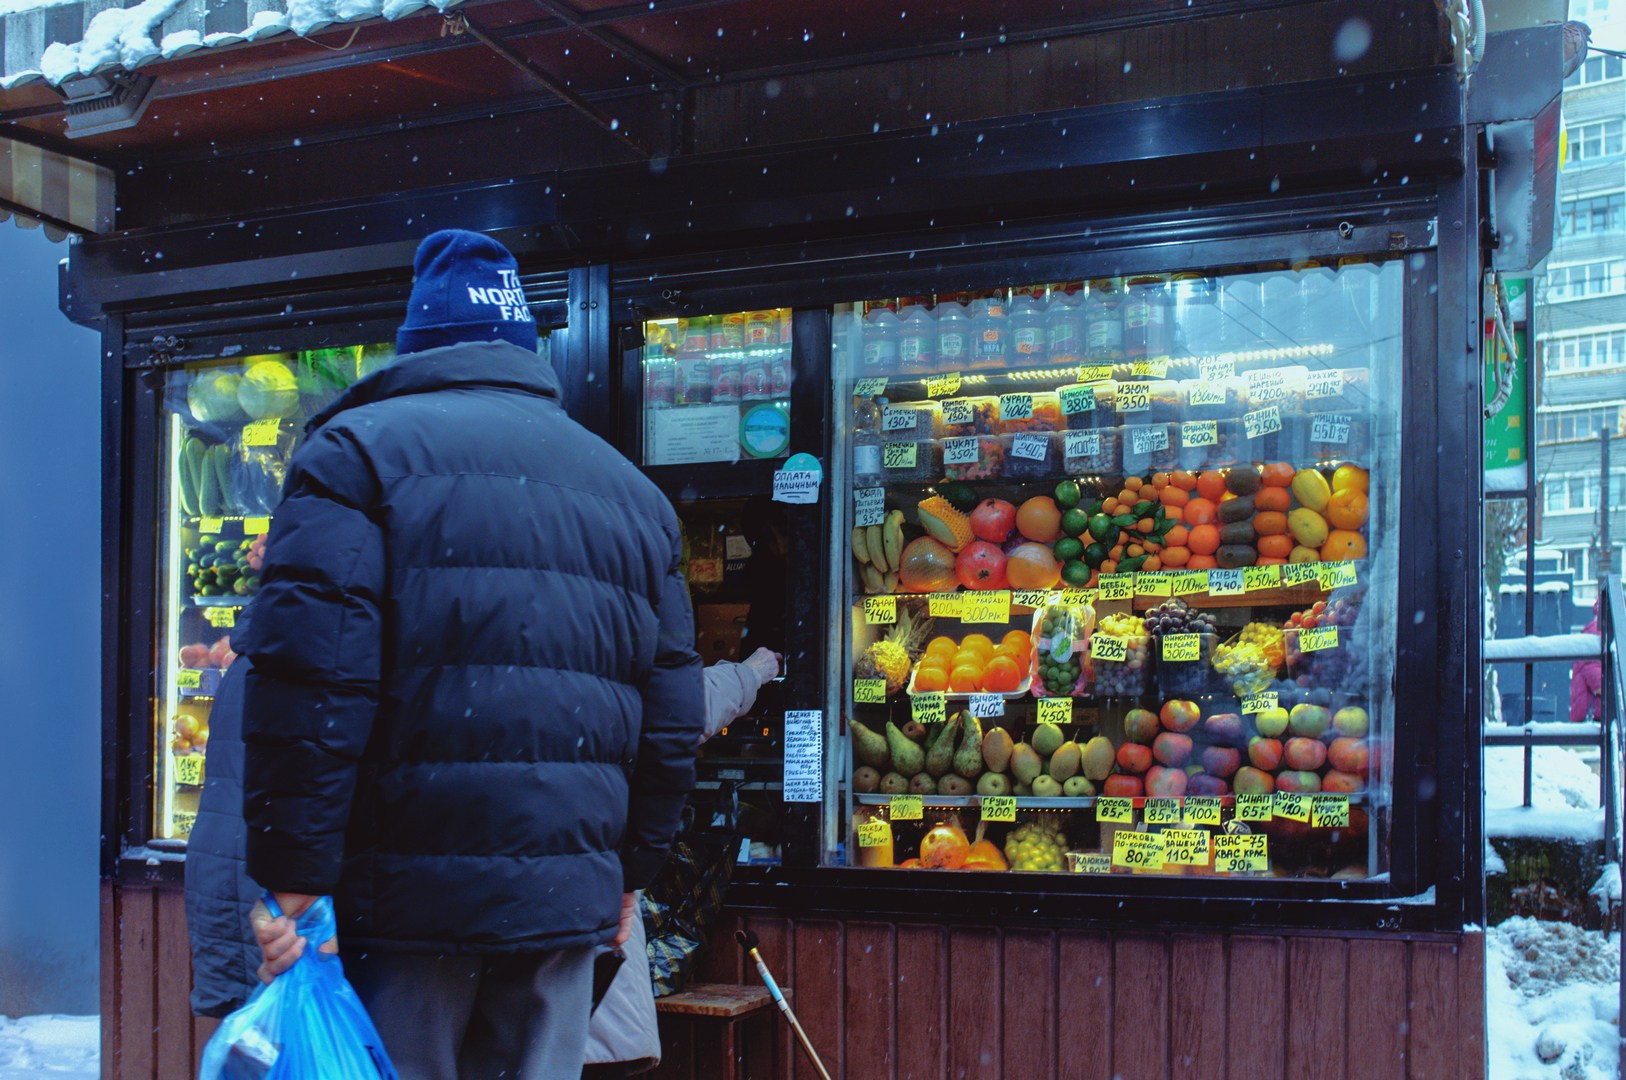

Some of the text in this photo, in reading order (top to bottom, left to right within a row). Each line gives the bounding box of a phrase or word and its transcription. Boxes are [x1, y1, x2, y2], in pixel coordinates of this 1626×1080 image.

[497, 269, 520, 288] TH
[500, 306, 531, 322] FAC
[1117, 384, 1149, 395] ИЗЮМ
[774, 472, 811, 482] ОПЛАТА
[773, 480, 819, 490] НАЛИЧНЫМ
[1209, 569, 1239, 580] КИВИ
[865, 598, 895, 608] БАНАН
[982, 797, 1013, 806] ГРУША
[1184, 796, 1221, 807] СПАРТАН
[1236, 793, 1270, 804] СИНАП
[1276, 790, 1302, 803] ЛОБО
[1115, 832, 1155, 842] МОРКОВЬ
[1164, 839, 1206, 848] ВАШЕНАЯ
[1215, 848, 1240, 859] КВАС
[1076, 856, 1109, 865] КЛЮКВА
[1227, 859, 1252, 871] 90р
